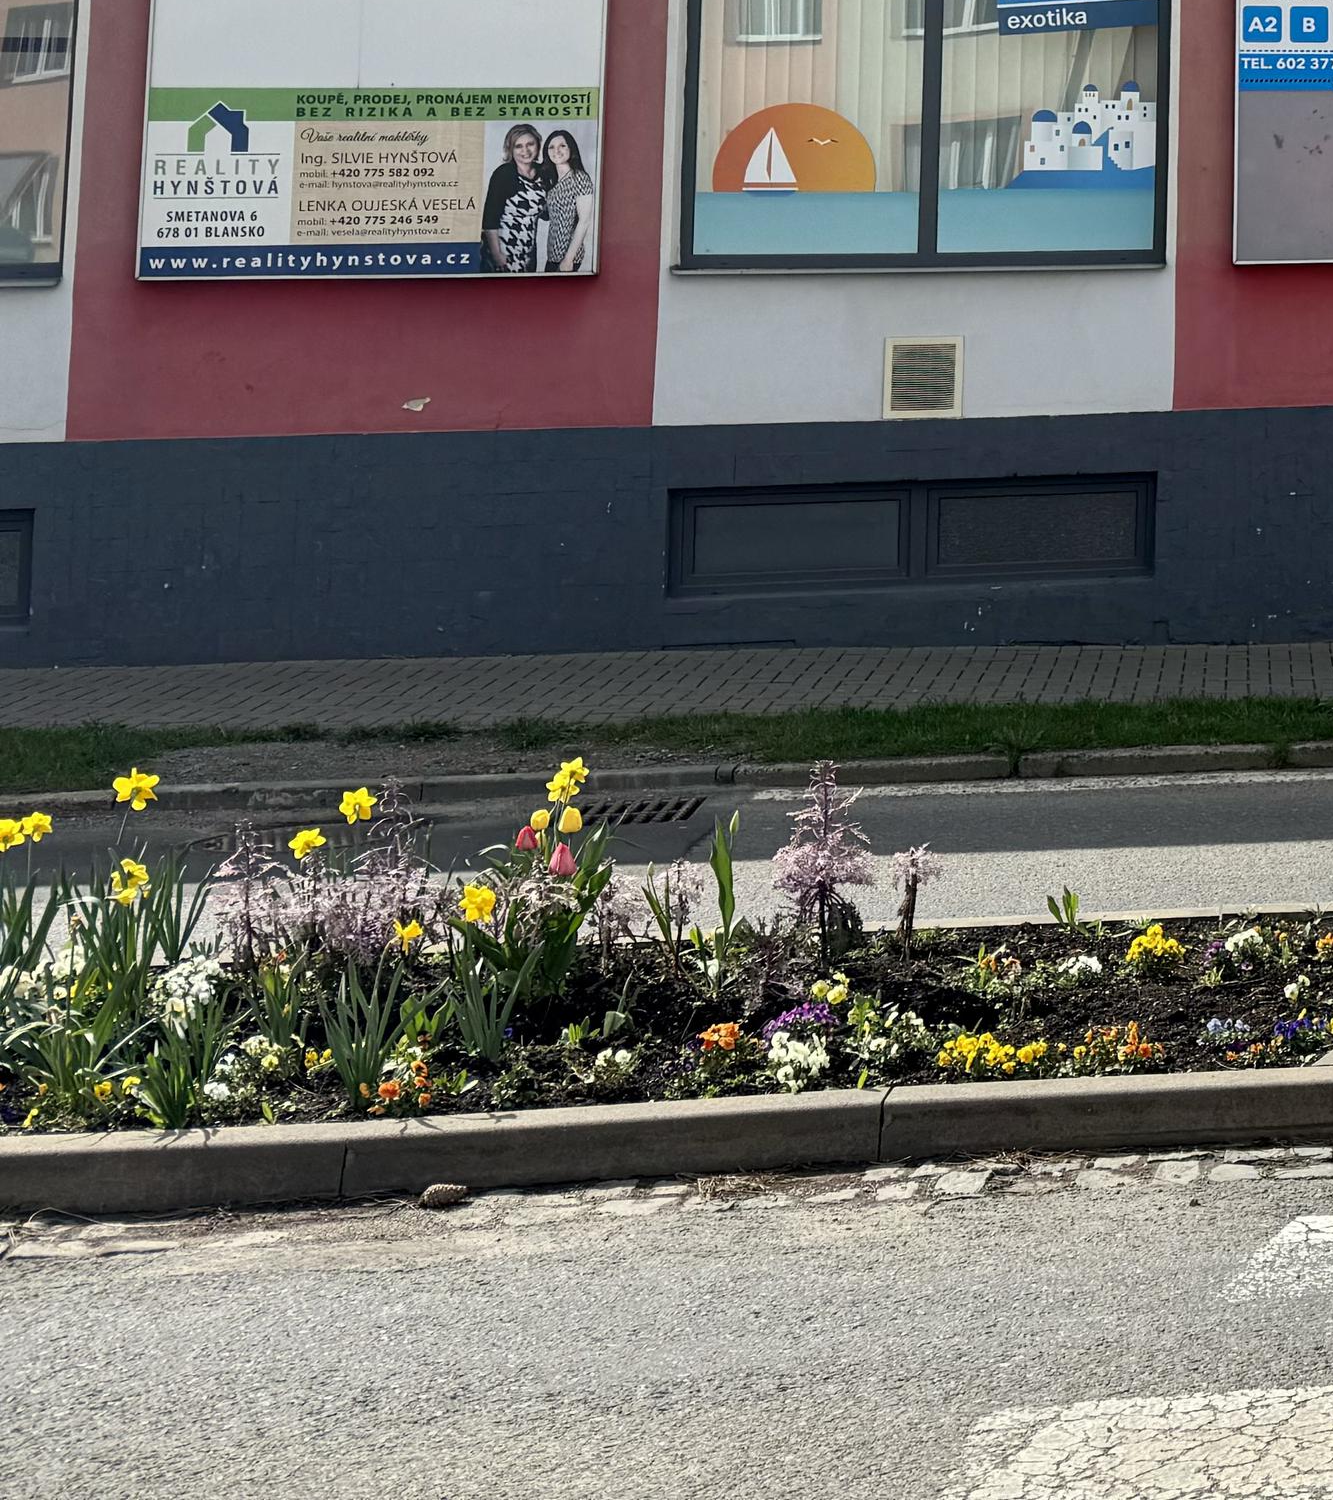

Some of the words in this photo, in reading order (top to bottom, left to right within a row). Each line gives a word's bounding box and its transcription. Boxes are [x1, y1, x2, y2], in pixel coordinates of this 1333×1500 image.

[1006, 8, 1087, 30] exotika
[1248, 17, 1277, 33] A2
[1302, 17, 1316, 32] B
[1241, 58, 1272, 69] TEL.
[1276, 58, 1306, 70] 602
[296, 92, 348, 106] KOUPĚ,
[353, 94, 411, 106] PRODEJ,
[416, 91, 492, 105] PRONÁJEM
[497, 91, 591, 105] NEMOVITOSTÍ
[296, 107, 332, 117] BEZ
[345, 107, 412, 117] RIZIKA
[426, 107, 437, 117] A
[450, 106, 485, 117] BEZ
[498, 105, 591, 117] STAROSTÍ
[300, 127, 334, 143] Vaše
[301, 153, 326, 166] Ing.
[331, 152, 374, 164] SILVIE
[378, 150, 458, 164] HYNŠTOVÁ
[154, 158, 280, 176] REALITY
[299, 169, 328, 178] mobil:
[330, 168, 360, 178] +420
[364, 168, 385, 177] 775
[388, 168, 410, 177] 582
[413, 168, 435, 177] 092
[153, 176, 279, 195] HYNŠTOVÁ
[299, 181, 330, 189] e-mail:
[299, 200, 347, 212] LENKA
[351, 196, 418, 212] OUJESKÁ
[422, 196, 476, 211] VESELÁ
[166, 211, 245, 222] SMETANOVA
[250, 211, 258, 221] 6
[297, 217, 327, 226] mobil:
[329, 216, 361, 226] +420
[364, 216, 386, 225] 775
[390, 215, 413, 225] 246
[416, 215, 439, 224] 549
[157, 227, 180, 238] 678
[184, 227, 199, 238] 01
[205, 226, 265, 238] BLANSKO
[296, 229, 329, 237] e-mail:
[149, 252, 470, 270] www.realityhynstova.cz
